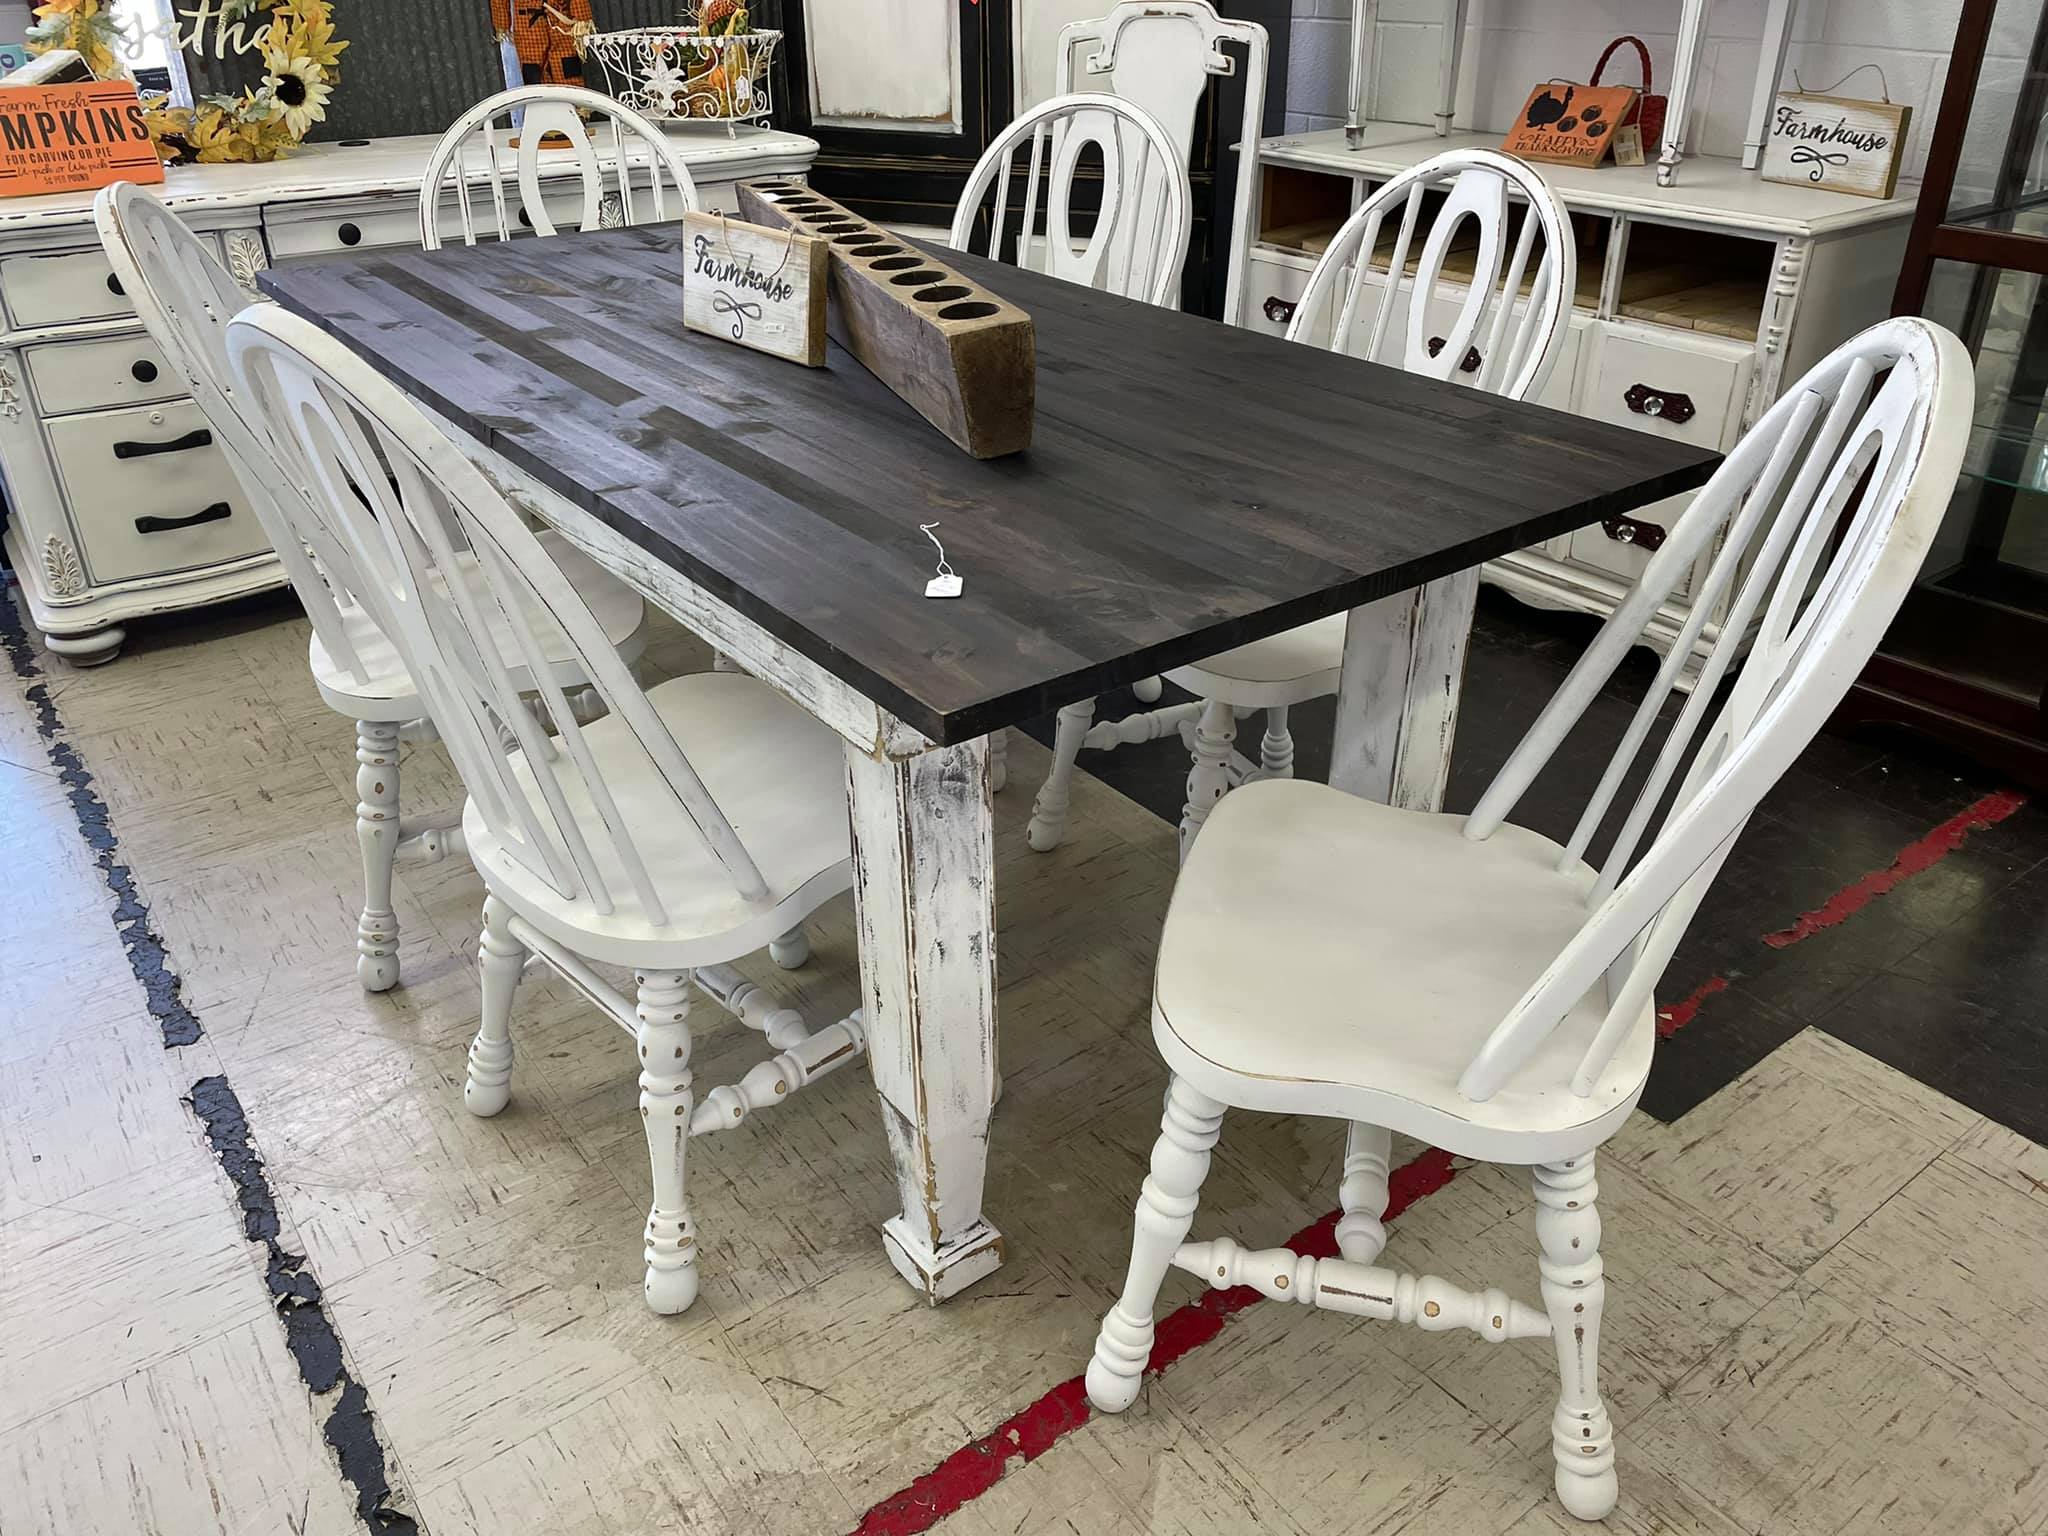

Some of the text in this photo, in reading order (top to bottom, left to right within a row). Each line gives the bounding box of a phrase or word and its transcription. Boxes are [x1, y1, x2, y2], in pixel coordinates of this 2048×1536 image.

[118, 0, 273, 60] gathe
[0, 91, 89, 113] Farm Fresh
[0, 105, 149, 151] MPKINS
[1773, 106, 1888, 152] Farmhouse
[1514, 142, 1595, 157] THANKSGIVING
[1533, 133, 1582, 147] HAPPY
[5, 147, 112, 165] FOR CARVING OR PIE
[68, 173, 89, 183] POUND
[694, 234, 794, 303] Farmhouse
